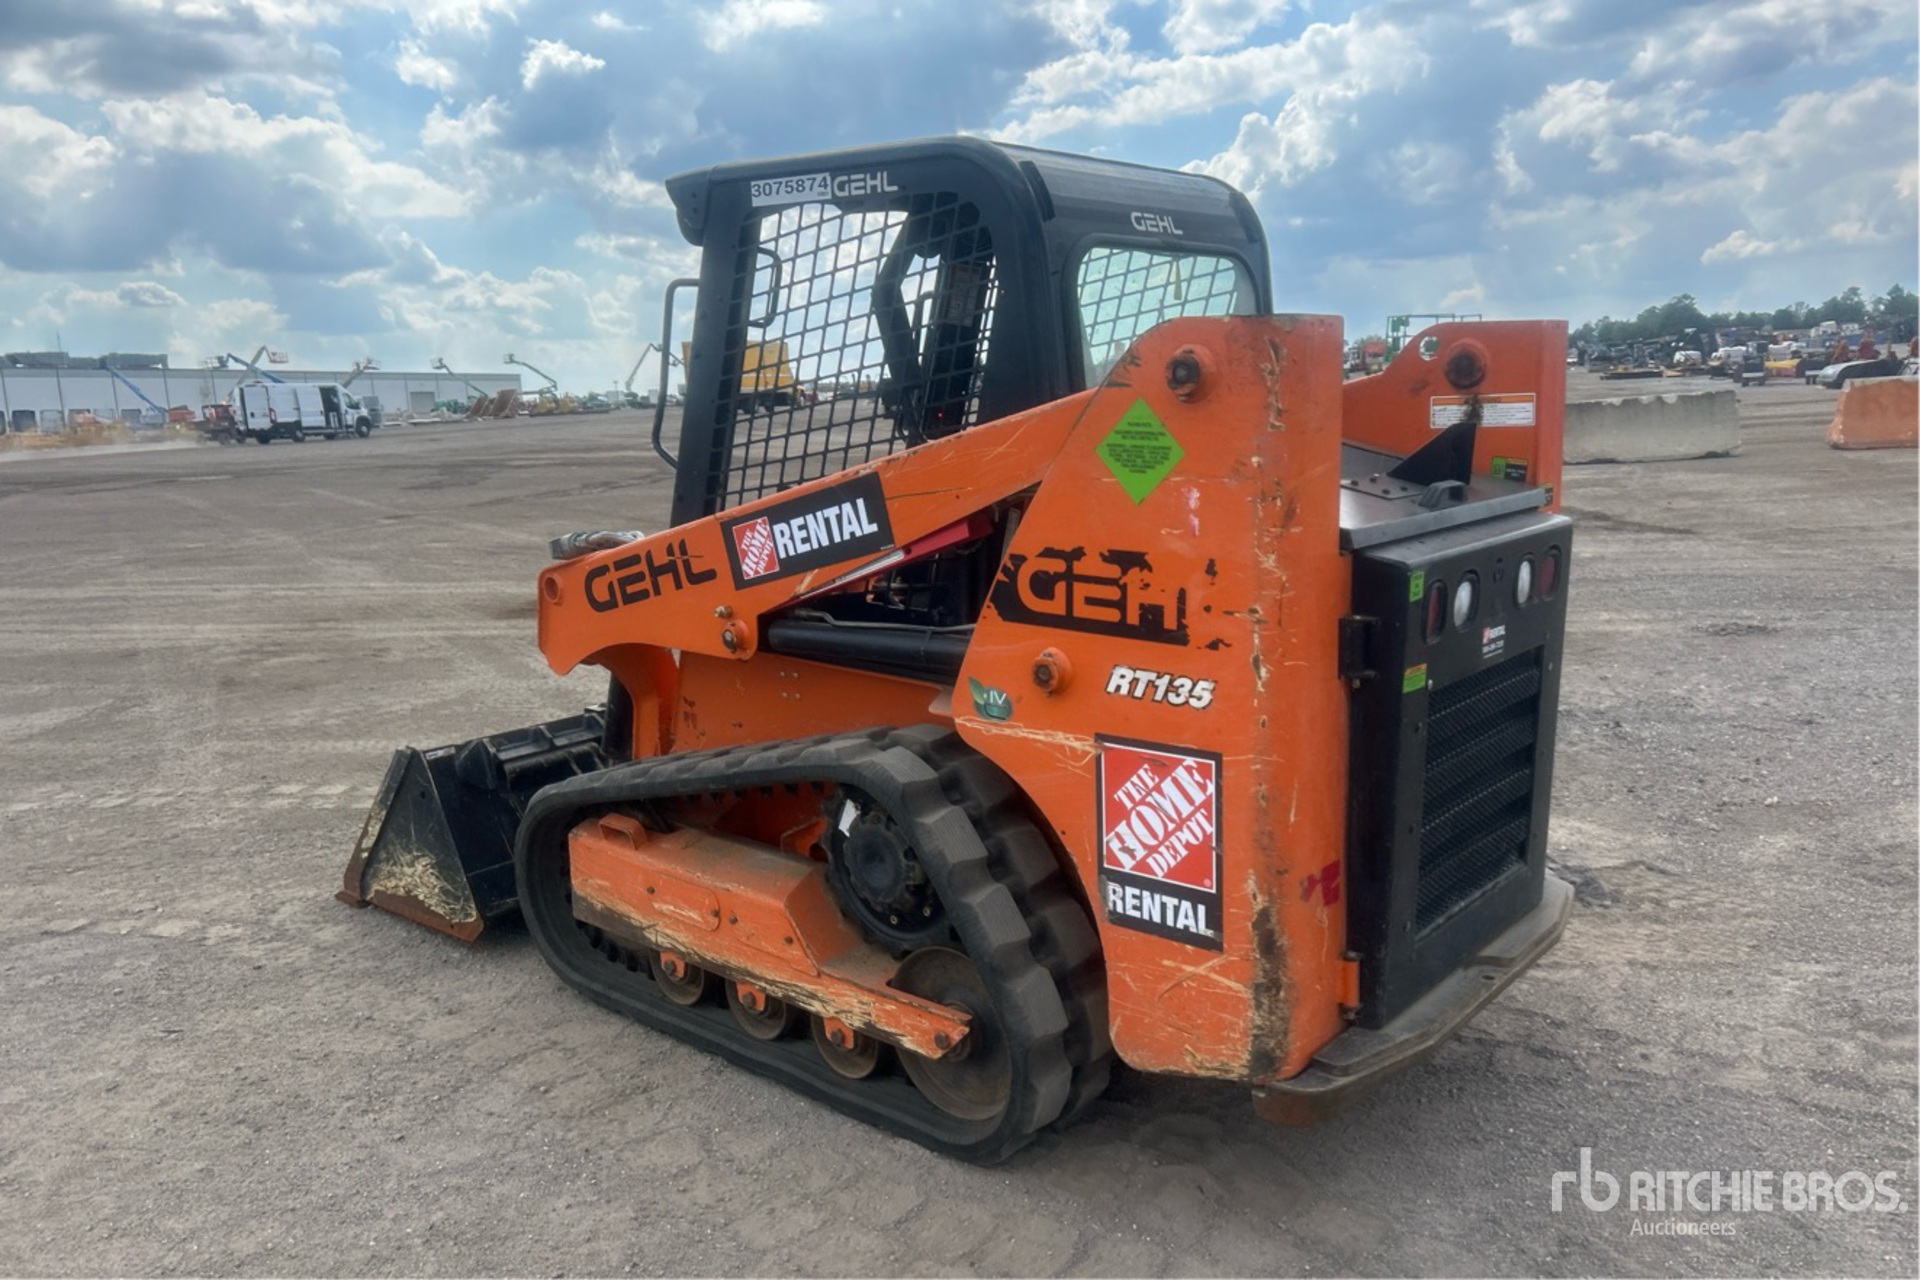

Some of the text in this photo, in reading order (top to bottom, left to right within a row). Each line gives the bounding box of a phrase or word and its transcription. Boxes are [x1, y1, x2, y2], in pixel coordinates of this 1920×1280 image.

[752, 176, 829, 198] 3075874
[833, 170, 899, 197] GEHL
[1130, 211, 1184, 235] GEHL
[741, 528, 756, 551] THE
[741, 519, 770, 577] HOME
[773, 498, 879, 559] RENTAL
[584, 538, 717, 613] GEHL
[757, 538, 774, 574] DEPOT
[1016, 553, 1190, 634] GEH
[1105, 664, 1218, 709] RT135
[1114, 763, 1159, 810] THE
[1105, 758, 1213, 870] HOME
[1146, 808, 1214, 878] DEPOT
[1107, 880, 1208, 936] RENTAL
